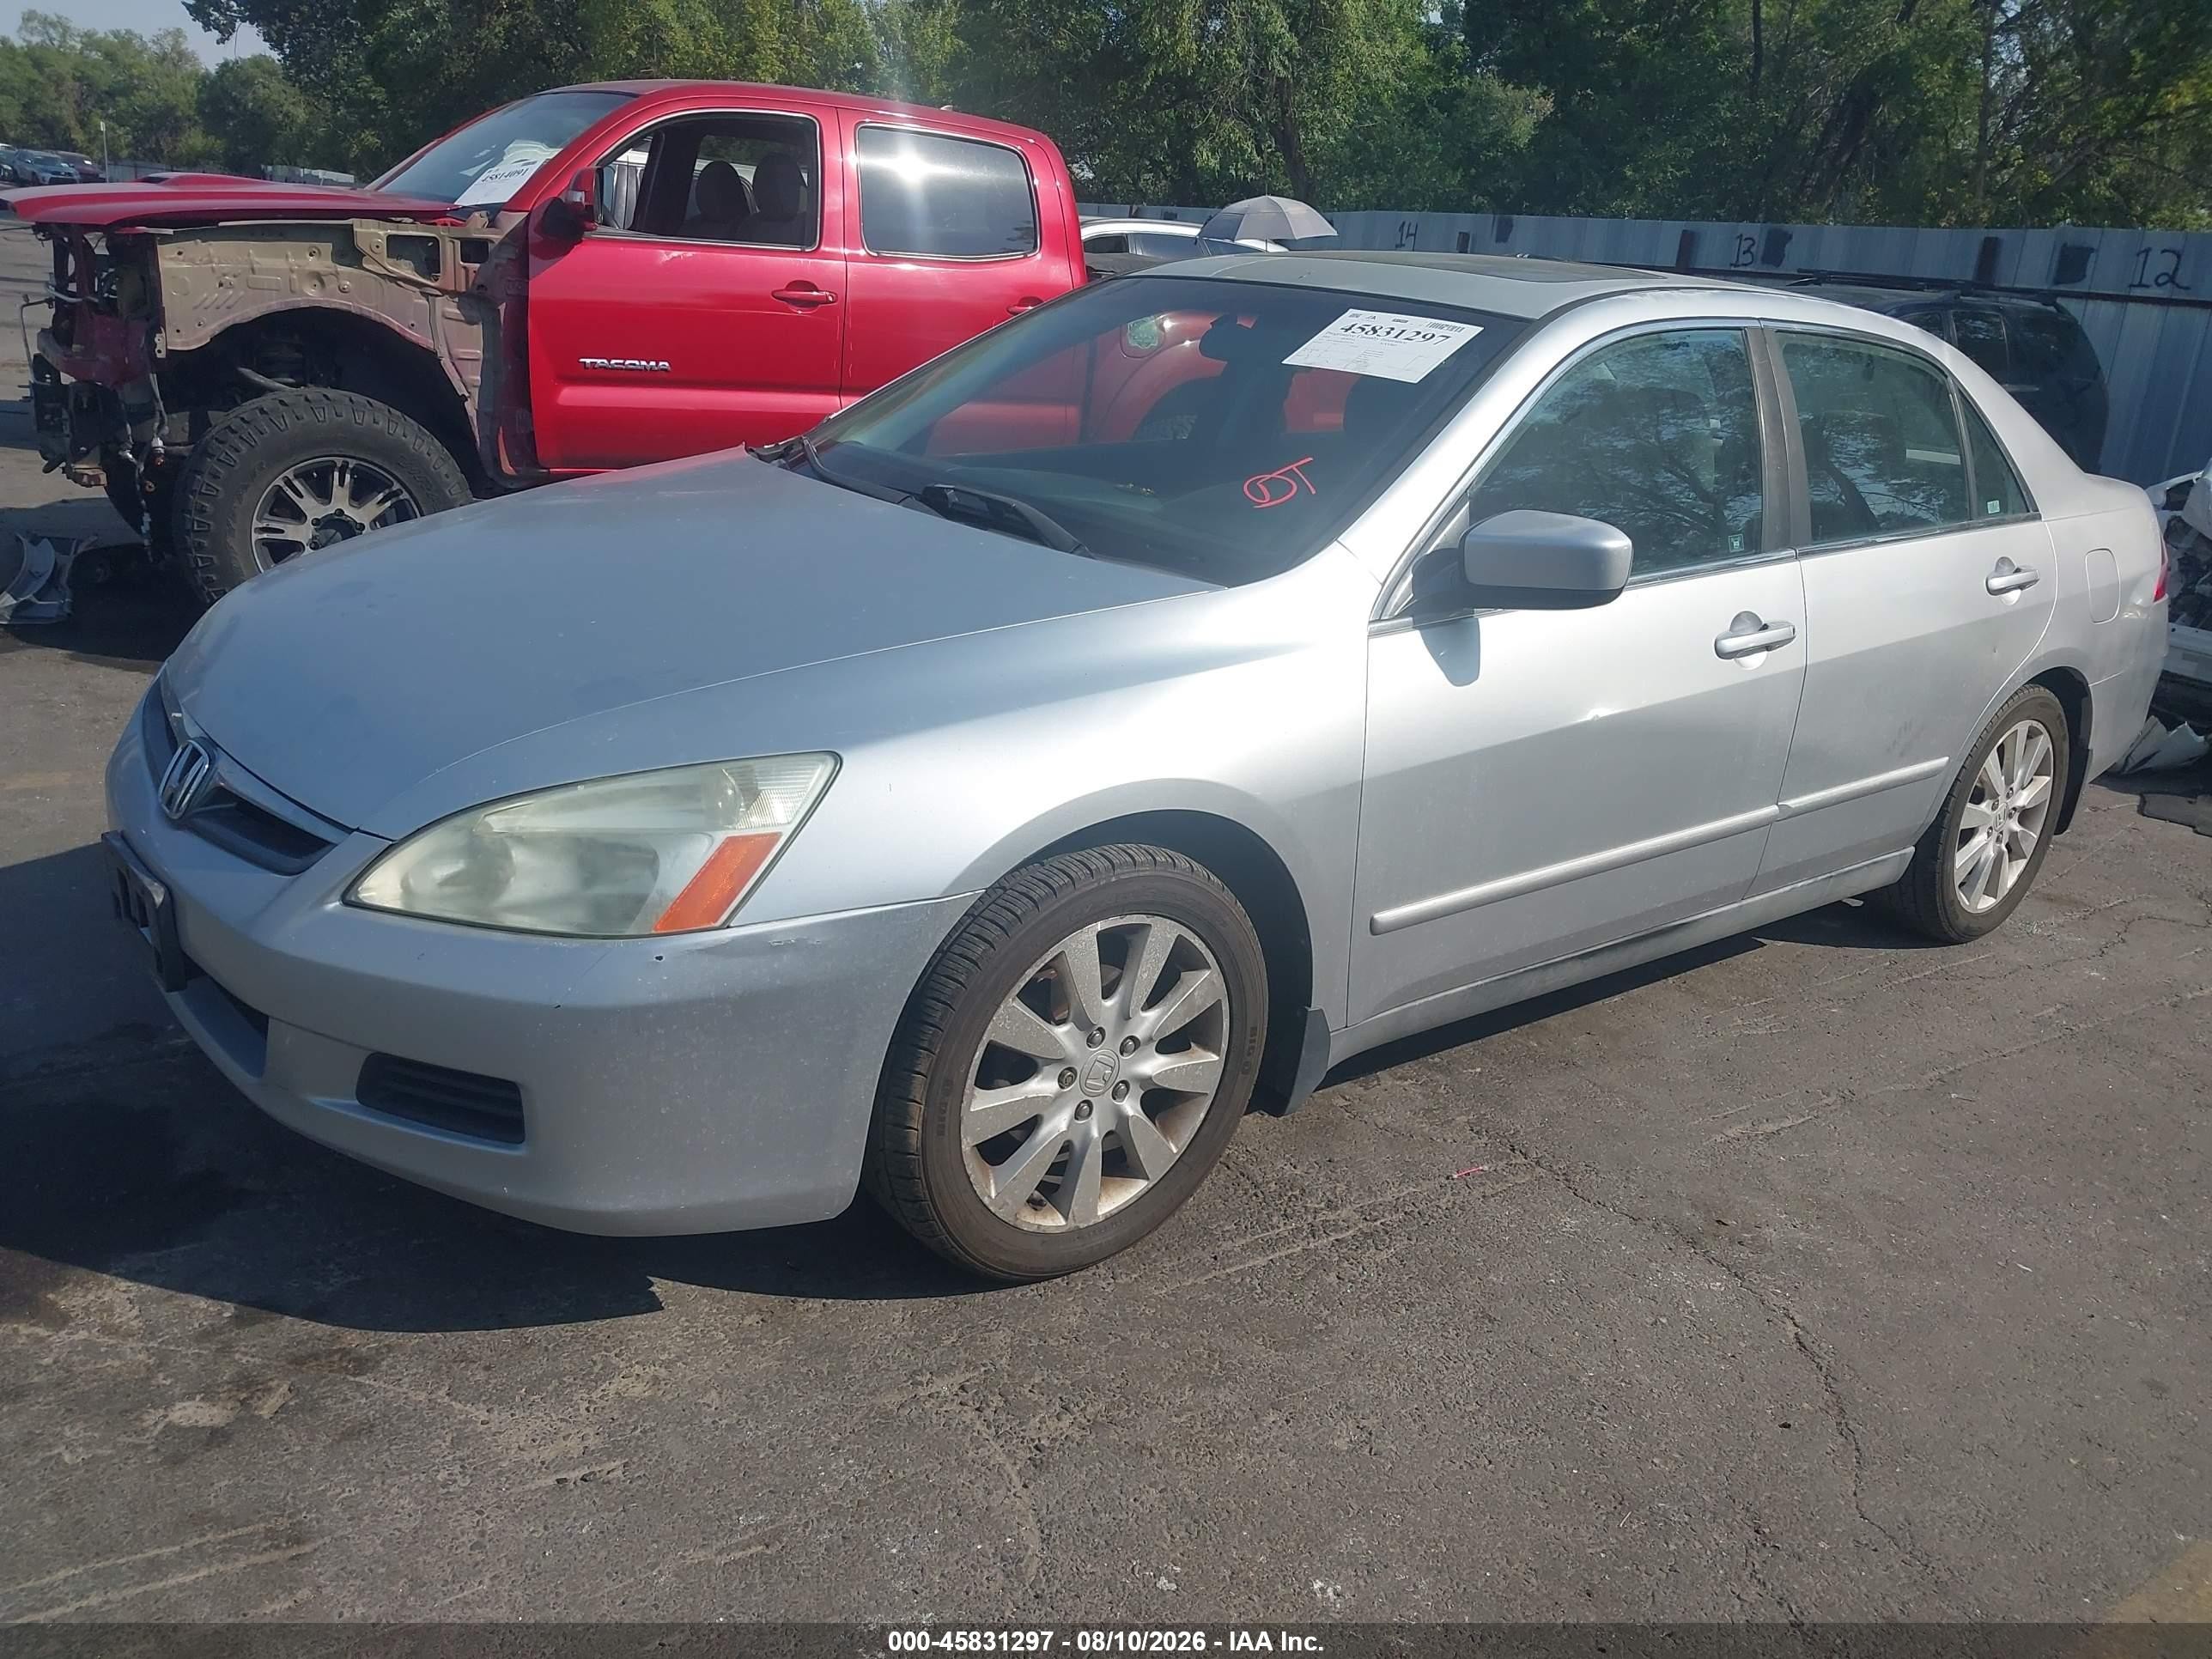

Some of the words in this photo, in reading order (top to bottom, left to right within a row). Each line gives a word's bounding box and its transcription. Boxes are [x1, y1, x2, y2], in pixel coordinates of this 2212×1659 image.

[1395, 221, 1419, 252] 14
[1729, 233, 1756, 268] 13
[2128, 246, 2191, 290] 12
[1340, 322, 1452, 345] 45831297
[579, 357, 671, 371] TACOMA
